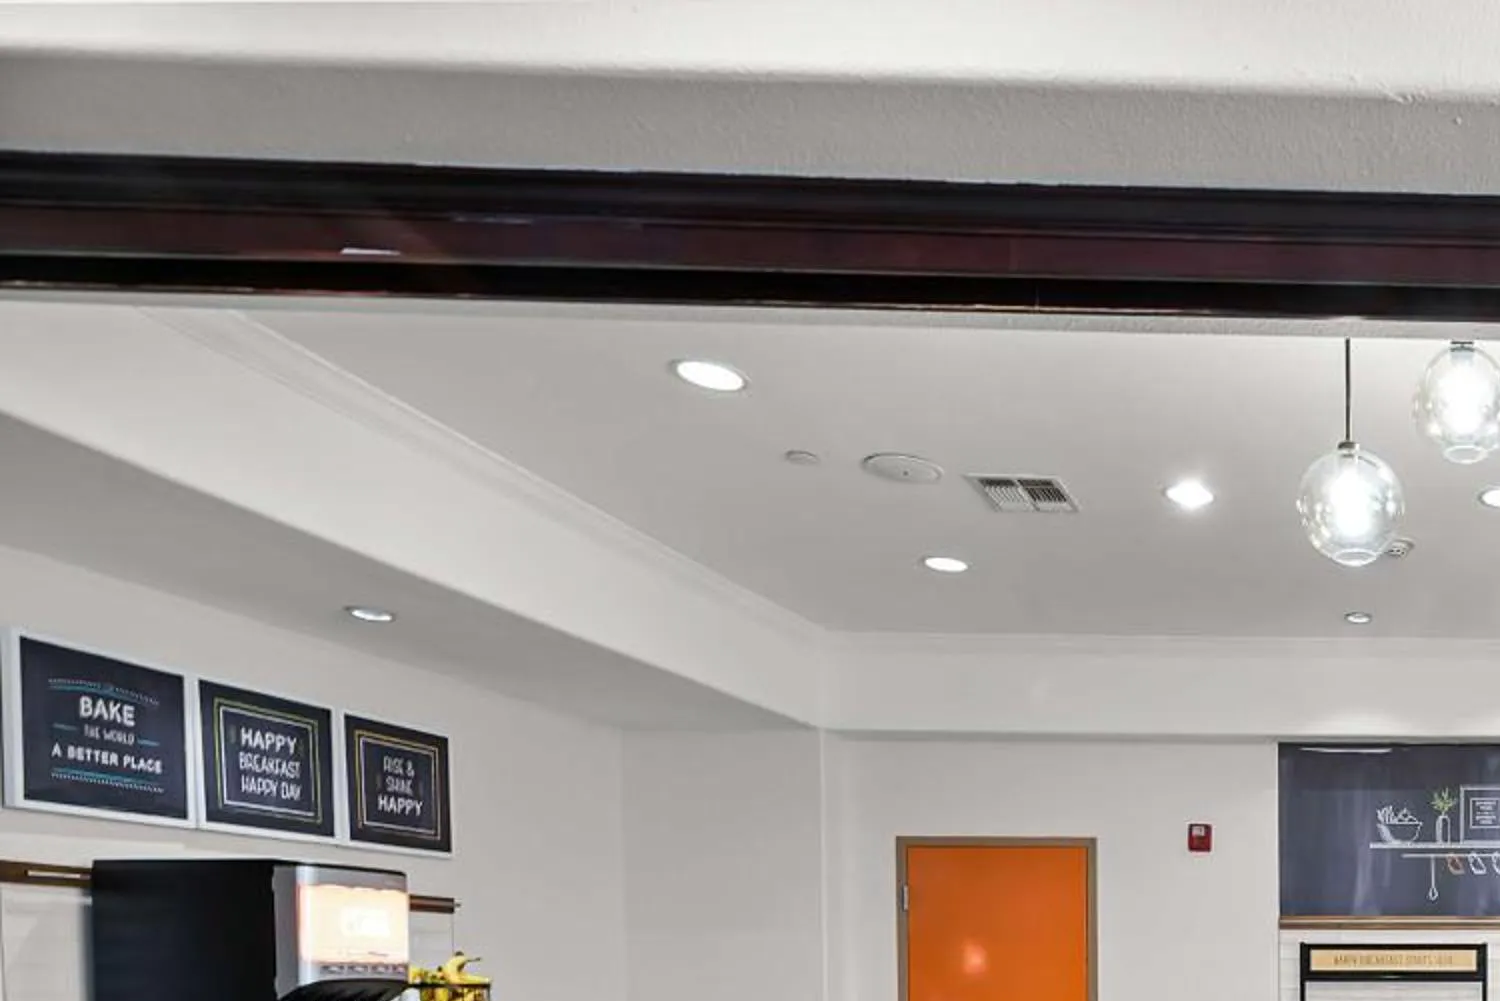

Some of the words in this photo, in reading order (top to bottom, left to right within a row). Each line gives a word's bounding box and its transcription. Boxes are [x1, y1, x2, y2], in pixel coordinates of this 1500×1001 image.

[79, 695, 135, 727] BAKE
[241, 727, 296, 755] HAPPY
[51, 742, 62, 757] A
[67, 745, 118, 766] BETTER
[123, 754, 162, 774] PLACE
[239, 751, 301, 779] BREAKFAST
[241, 775, 278, 797] HAPPY
[281, 781, 302, 801] DAY
[377, 794, 424, 816] HAPPY
